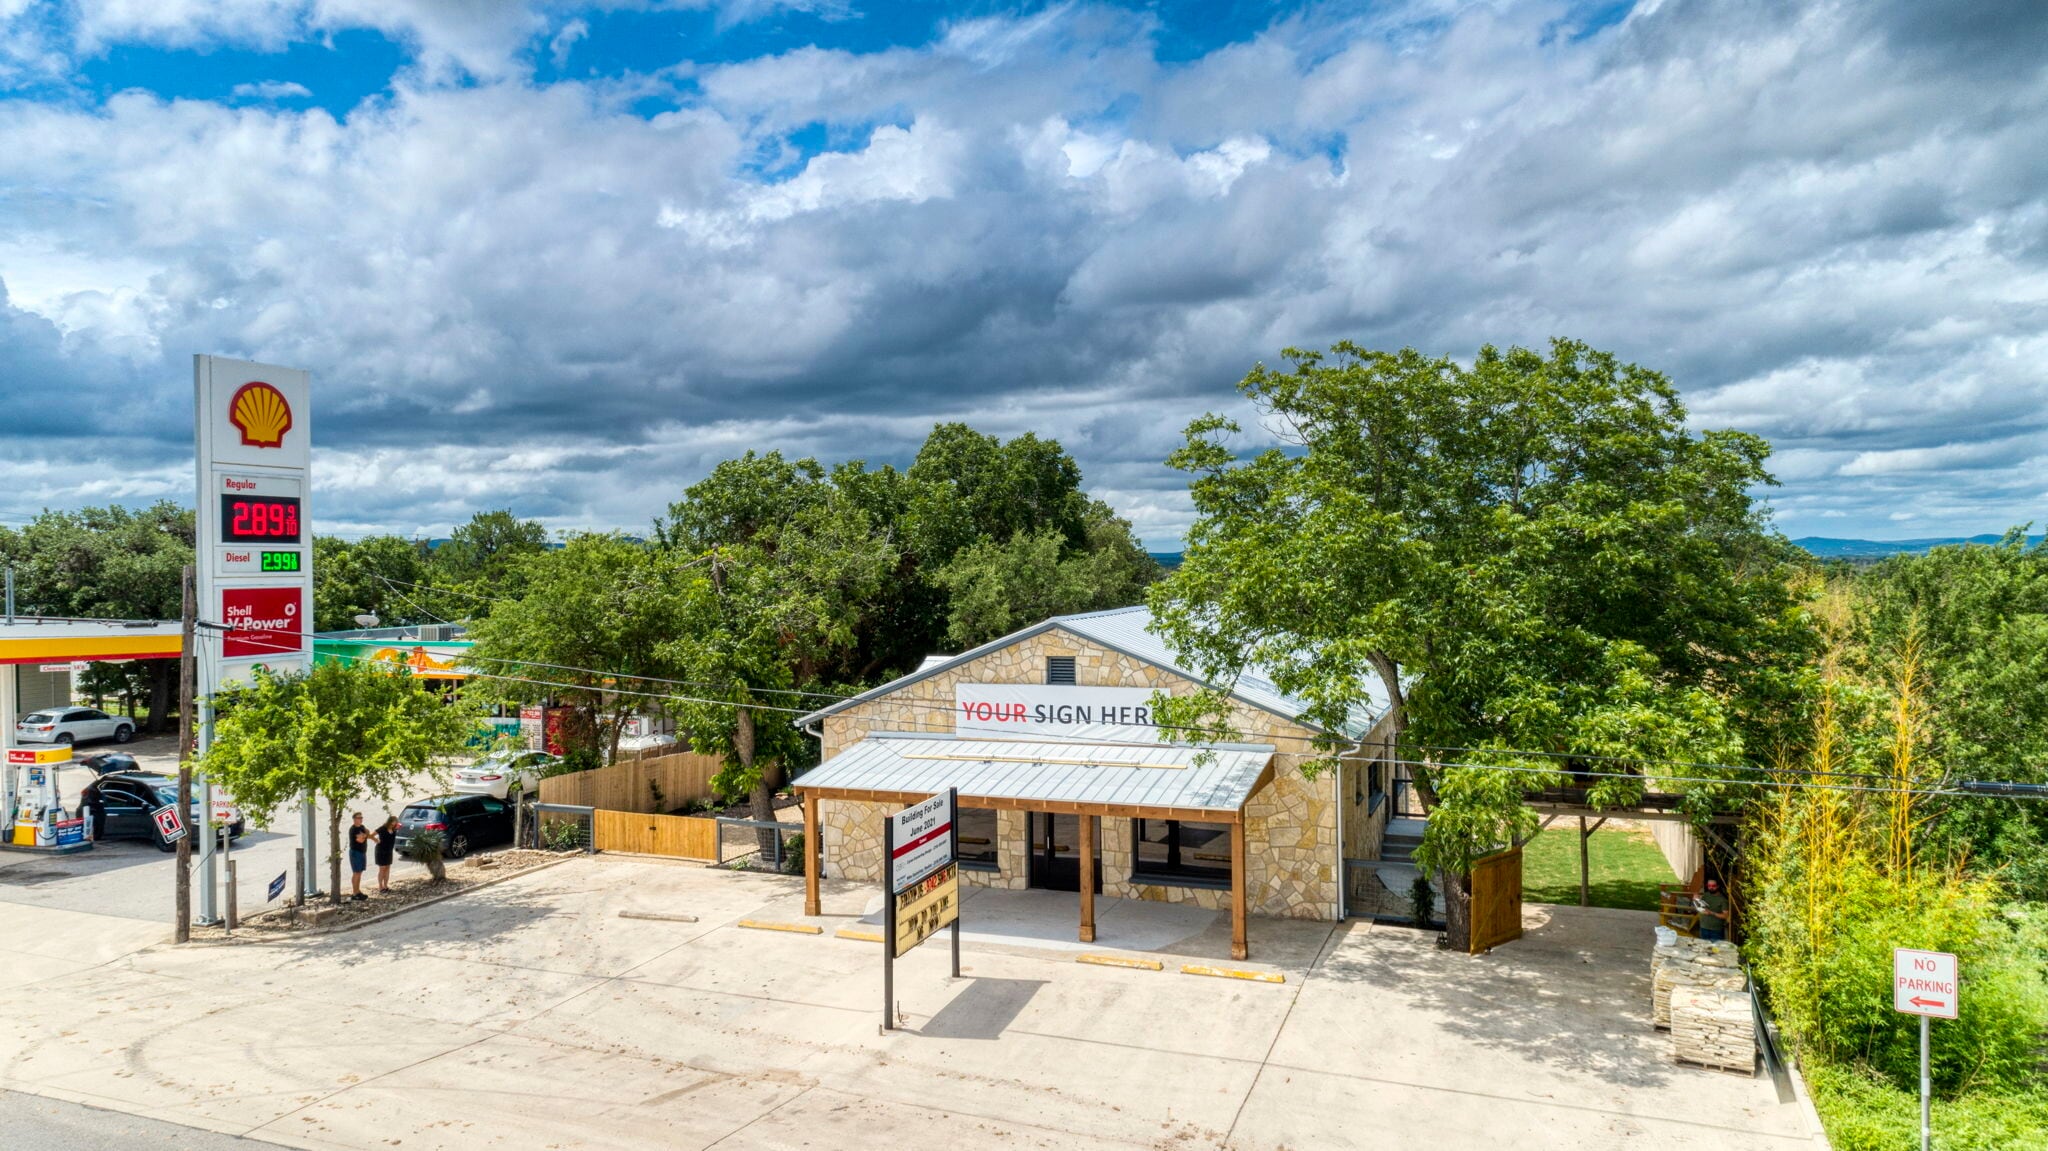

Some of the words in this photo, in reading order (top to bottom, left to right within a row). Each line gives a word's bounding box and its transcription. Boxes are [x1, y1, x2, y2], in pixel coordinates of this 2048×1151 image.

[226, 478, 256, 491] Regular
[232, 502, 284, 536] 2.89
[226, 552, 250, 562] Diesel
[263, 553, 290, 570] 2.99
[227, 605, 252, 616] Shell
[227, 617, 290, 631] V-Power
[962, 702, 1027, 723] YOUR
[1034, 704, 1091, 725] SIGN
[901, 809, 923, 825] Building
[924, 805, 932, 815] For
[933, 799, 944, 810] Sale
[910, 825, 923, 837] June
[924, 816, 936, 830] 2021
[1914, 958, 1936, 972] NO
[1899, 976, 1953, 995] PARKING
